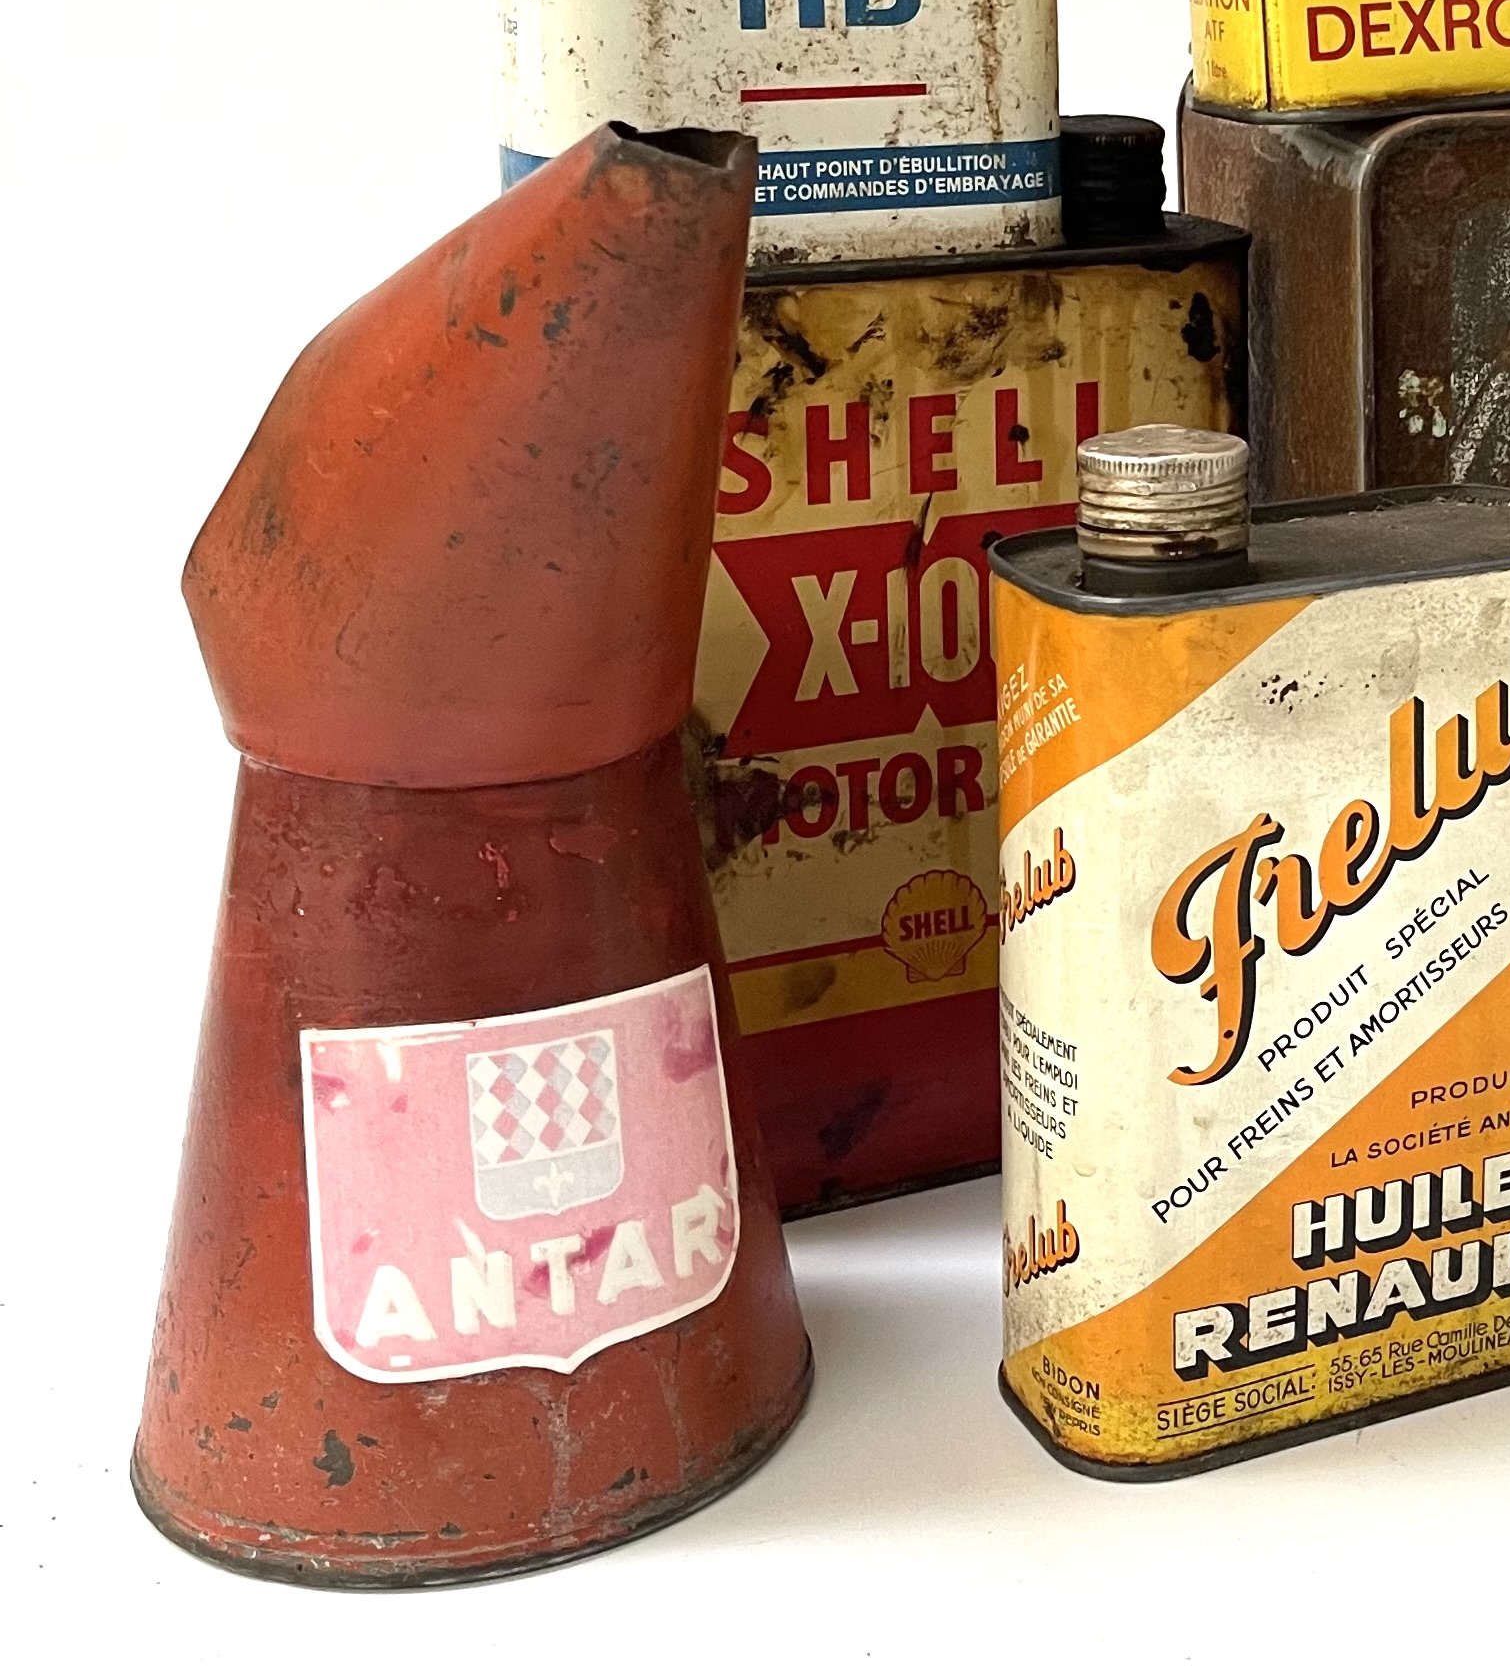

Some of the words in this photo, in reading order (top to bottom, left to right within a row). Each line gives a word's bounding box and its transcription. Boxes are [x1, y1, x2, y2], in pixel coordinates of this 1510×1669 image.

[1204, 19, 1225, 42] ATF
[754, 185, 778, 204] ET
[783, 179, 910, 201] COMMANDES
[758, 162, 811, 181] HAUT
[816, 159, 874, 178] POINT
[790, 555, 998, 702] X-10
[1048, 673, 1069, 698] SA
[1024, 697, 1081, 756] GARANTIE
[899, 906, 975, 942] SHELL
[1257, 965, 1369, 1073] PRODUIT
[1385, 868, 1490, 960] SPÉCIAL
[1151, 1155, 1228, 1224] POUR
[1227, 1078, 1314, 1161] FREINS
[1316, 1047, 1344, 1083] ET
[1350, 902, 1509, 1057] AMORTISSEURS
[1025, 1070, 1057, 1108] FREINS
[1063, 1095, 1078, 1116] ET
[1013, 1111, 1054, 1160] LIQUIDE
[1331, 1148, 1358, 1168] LA
[1367, 1115, 1472, 1160] SOCIÉTÉ
[355, 1185, 726, 1348] ANTAR
[1389, 1338, 1423, 1360] Rue
[1427, 1322, 1487, 1347] Camille
[1043, 1355, 1100, 1400] BIDON
[1157, 1397, 1226, 1431] SIÈGE
